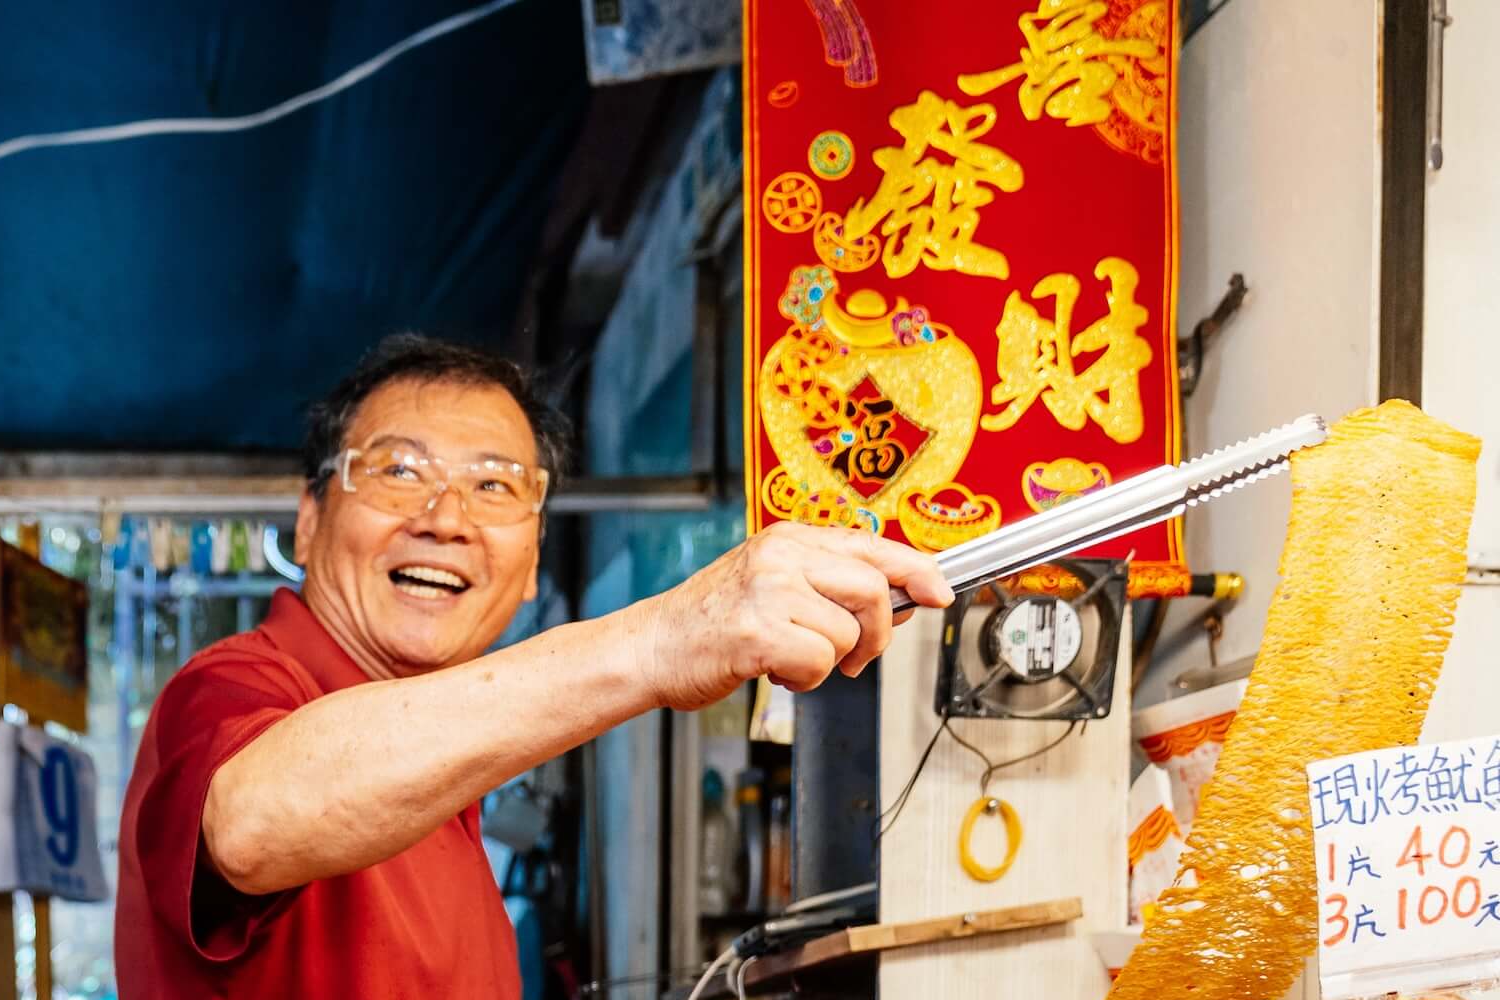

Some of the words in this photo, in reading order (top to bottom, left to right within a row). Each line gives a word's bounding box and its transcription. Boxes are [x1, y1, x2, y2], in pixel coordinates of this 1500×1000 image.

[39, 745, 79, 868] 9
[1327, 843, 1381, 886] 1片
[1395, 825, 1500, 876] 40元
[1323, 892, 1387, 947] 3片
[1397, 875, 1500, 930] 100元
